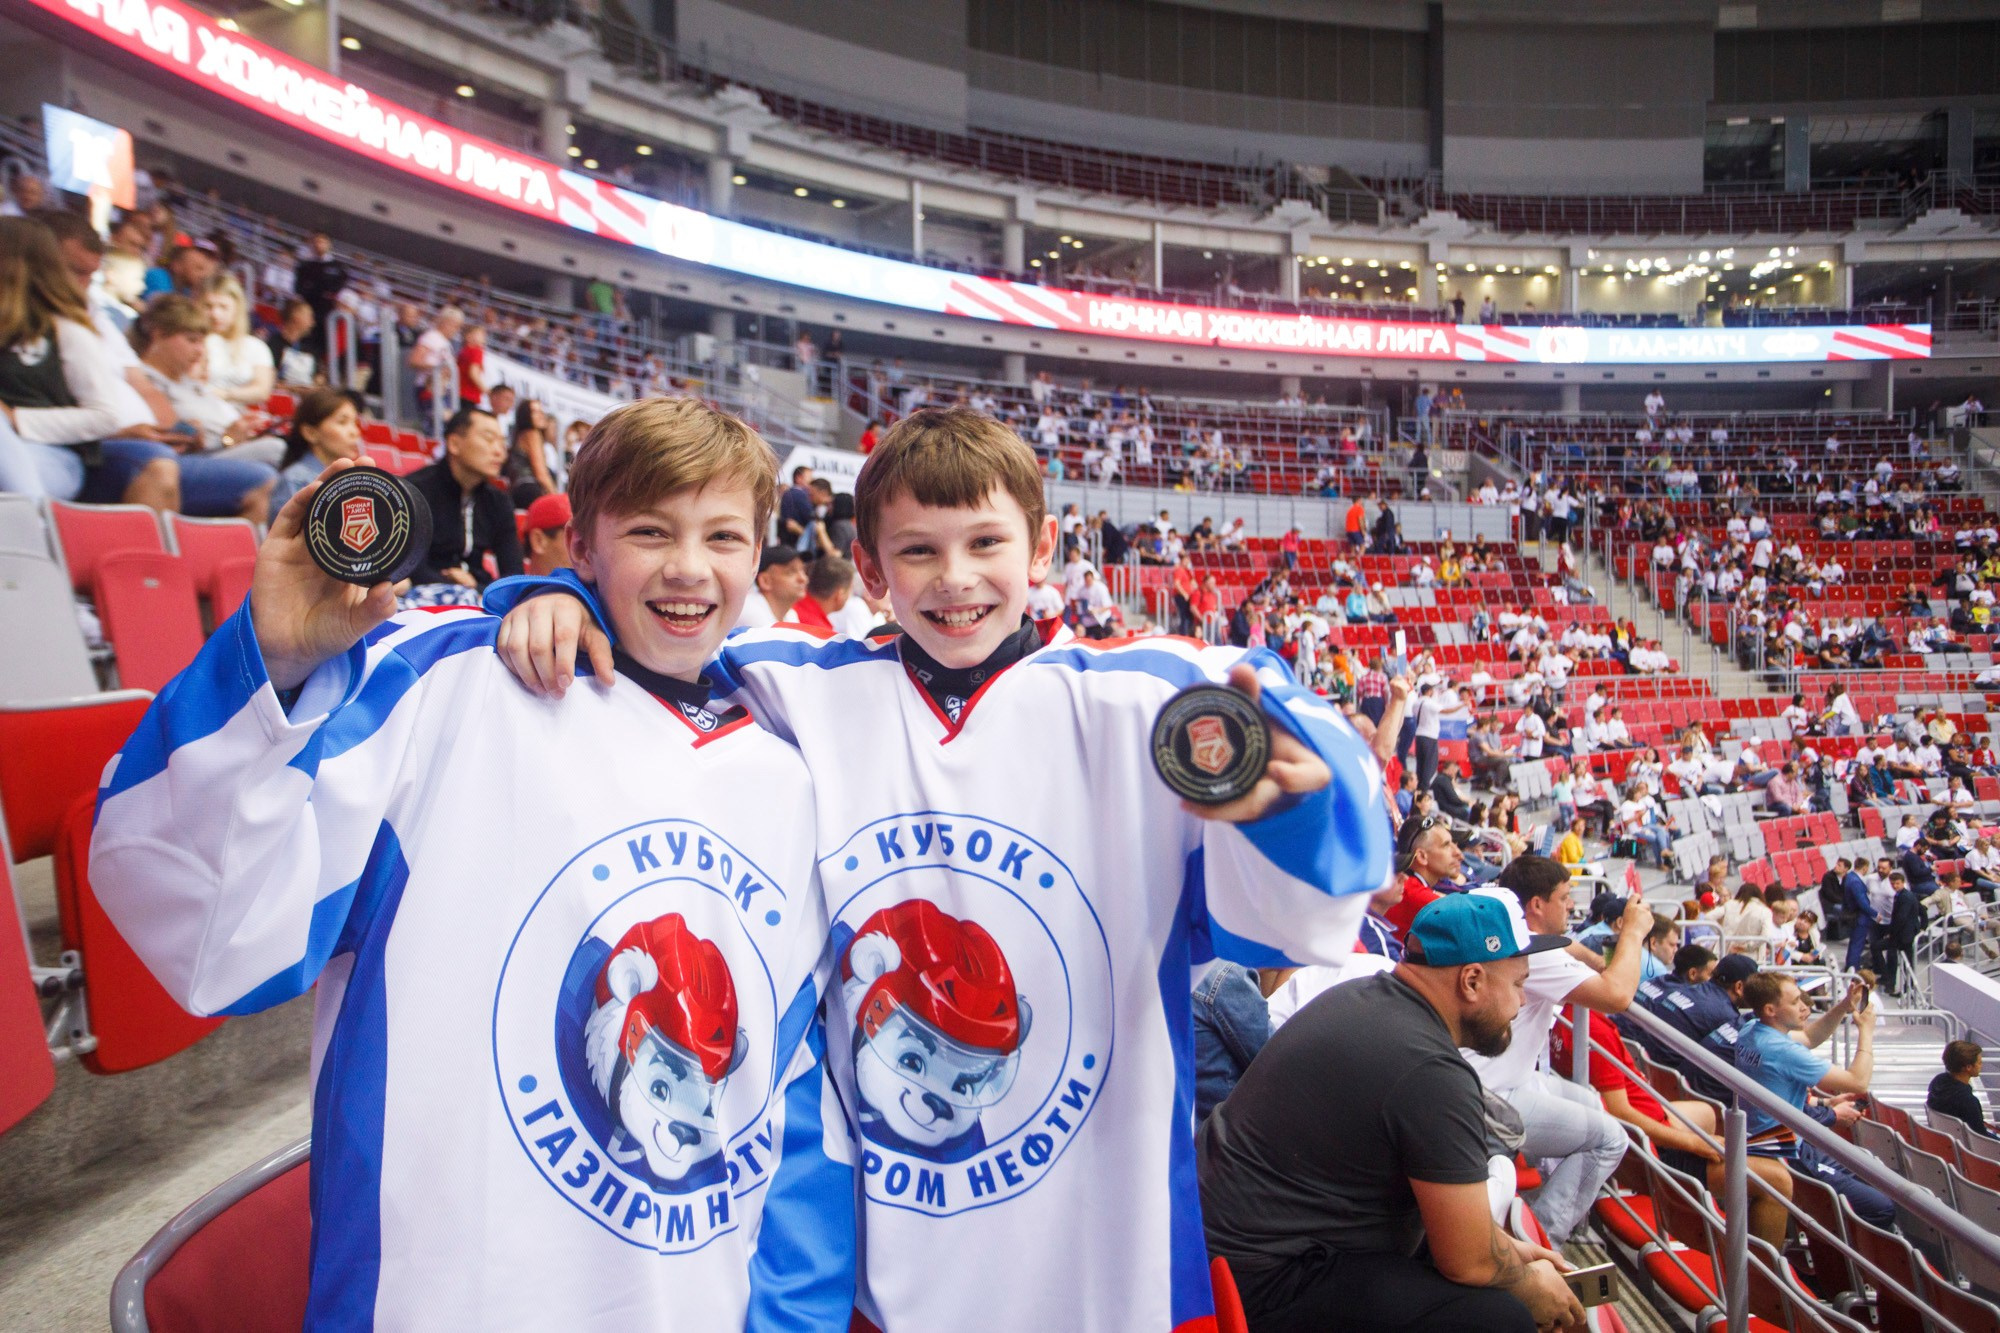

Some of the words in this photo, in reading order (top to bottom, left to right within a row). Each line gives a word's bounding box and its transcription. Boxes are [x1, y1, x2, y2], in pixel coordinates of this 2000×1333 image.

[197, 26, 452, 174] ХОККЕЙНАЯ
[456, 144, 555, 210] ЛИГА
[1089, 300, 1201, 338] НОЧНАЯ
[1208, 313, 1370, 349] ХОККЕЙНАЯ
[1377, 327, 1450, 353] ЛИГА
[1608, 334, 1746, 358] ГАЛА-МАТЧ
[351, 562, 372, 572] VII
[627, 831, 764, 912] КУБОК
[876, 822, 1033, 880] КУБОК
[863, 1148, 946, 1207] РОМ
[967, 1078, 1091, 1197] НЕФТИ
